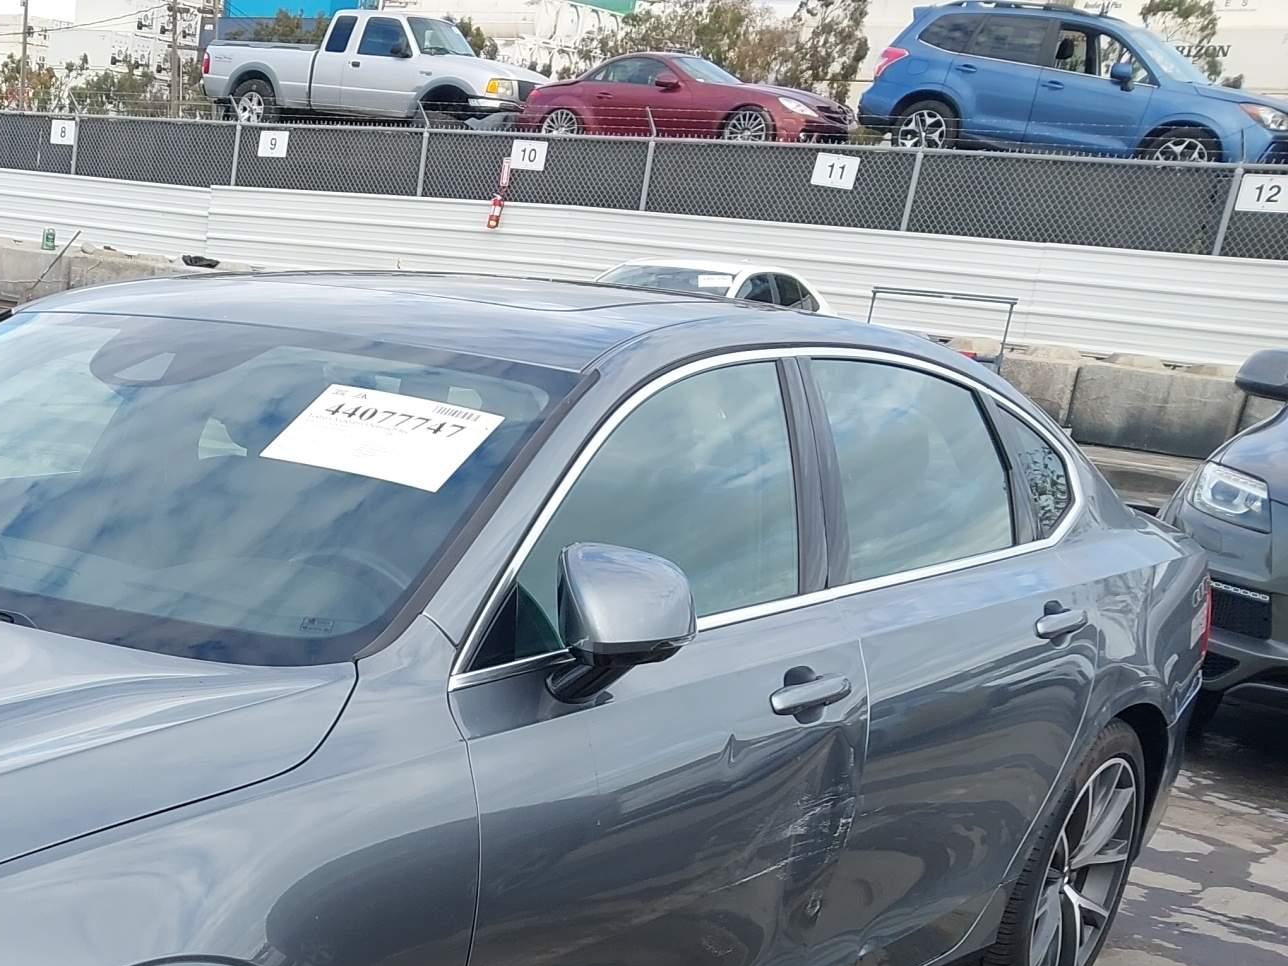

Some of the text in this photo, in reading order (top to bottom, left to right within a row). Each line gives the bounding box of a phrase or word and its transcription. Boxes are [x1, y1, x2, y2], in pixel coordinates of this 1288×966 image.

[60, 126, 67, 139] 8
[269, 137, 277, 150] 9
[520, 147, 537, 162] 10
[827, 162, 847, 180] 11
[1255, 183, 1282, 203] 12
[324, 402, 466, 438] 44077747
